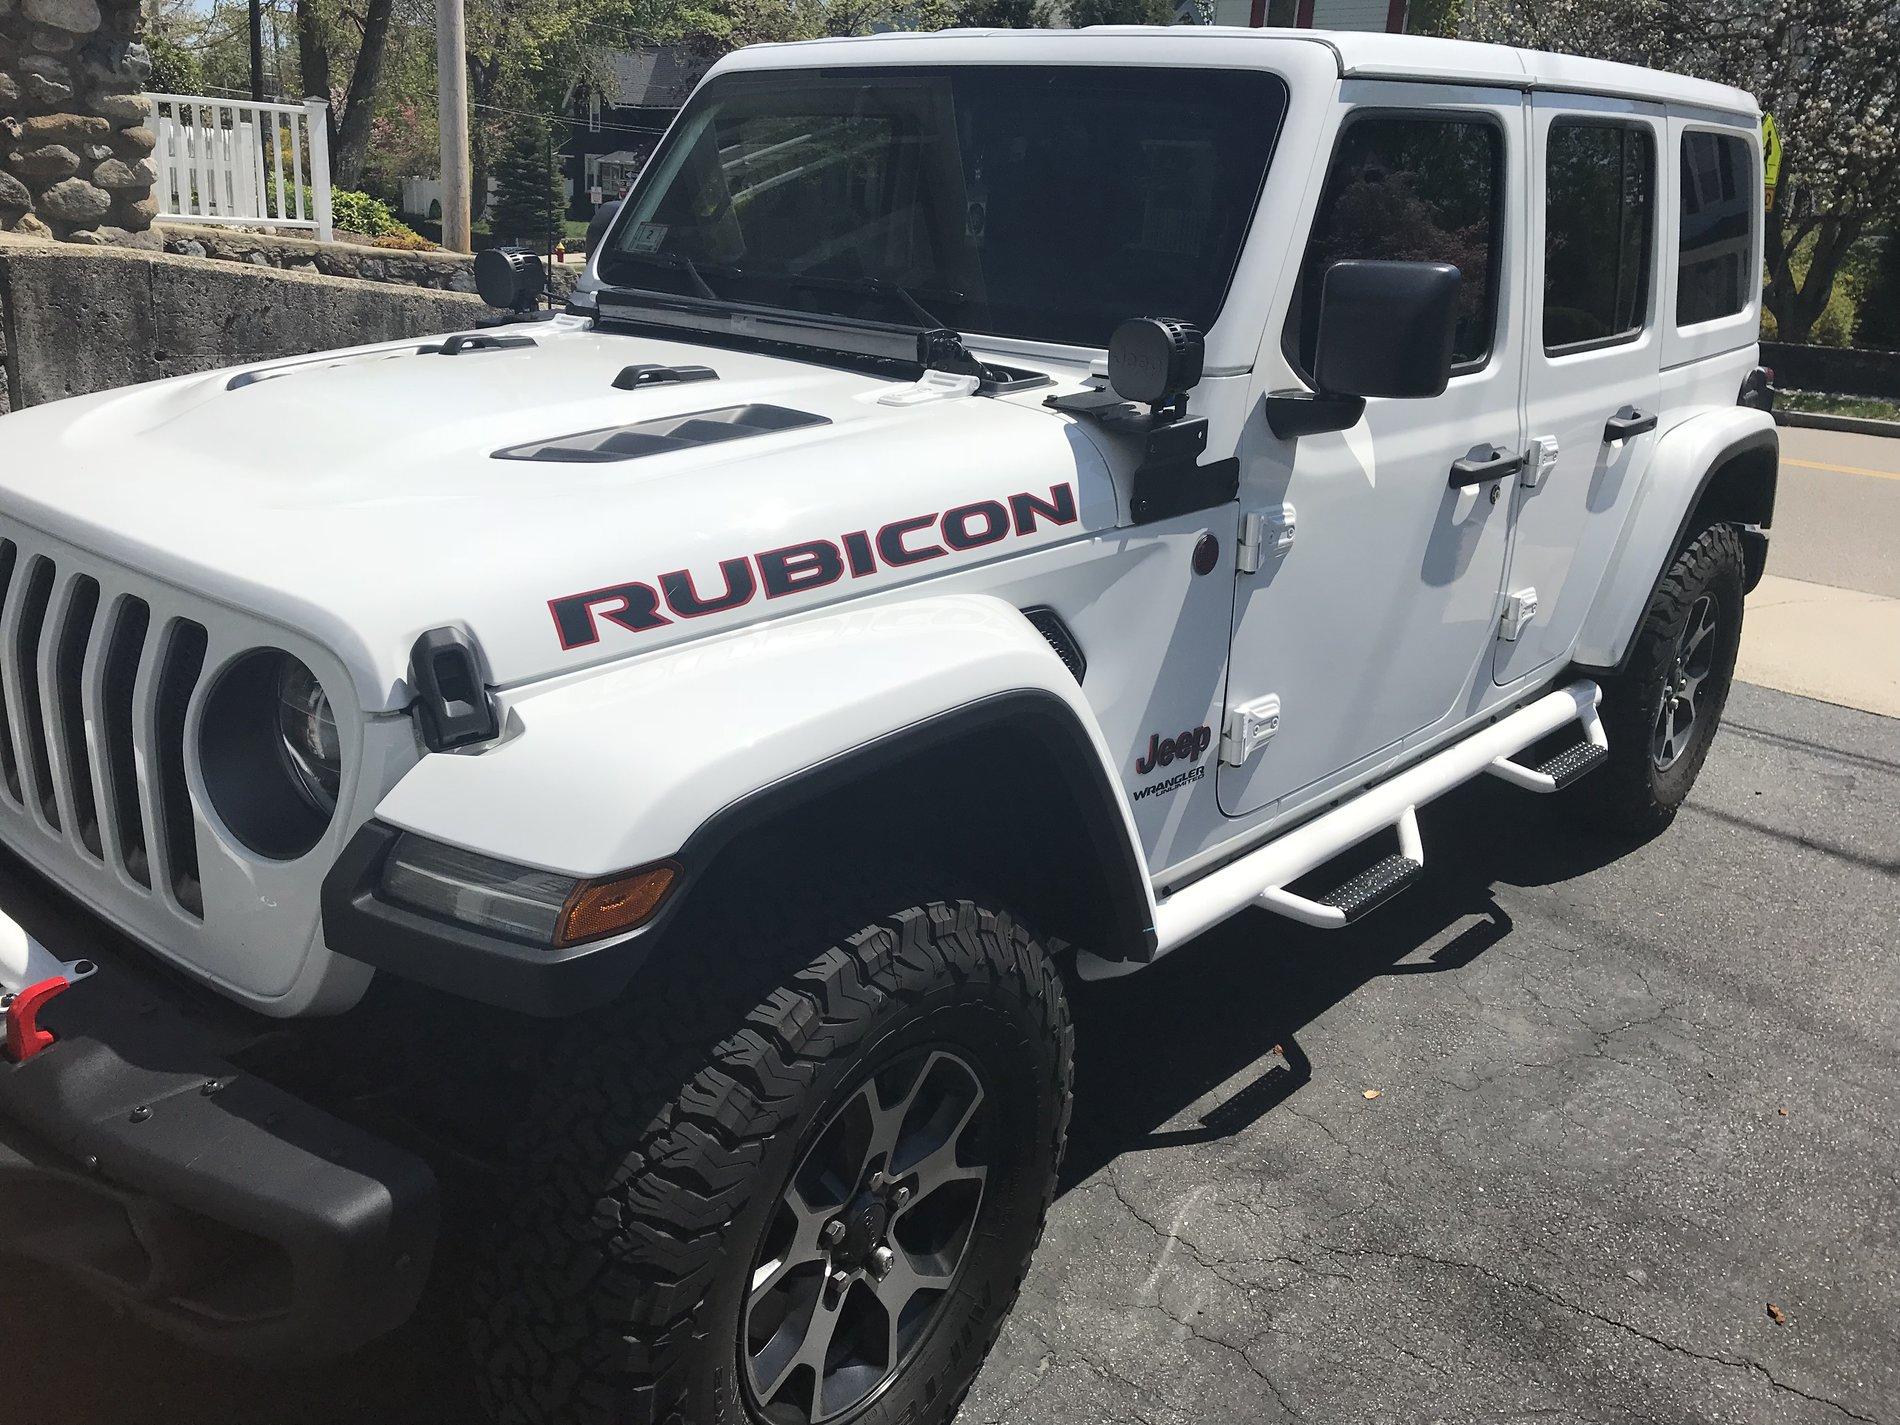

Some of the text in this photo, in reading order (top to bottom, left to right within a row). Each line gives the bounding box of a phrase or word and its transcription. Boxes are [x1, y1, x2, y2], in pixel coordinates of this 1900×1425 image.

[547, 482, 1077, 651] RUBICON
[1136, 726, 1211, 774] Jeep
[1133, 765, 1205, 801] WRANGLER
[1156, 773, 1205, 797] UNLIMITED
